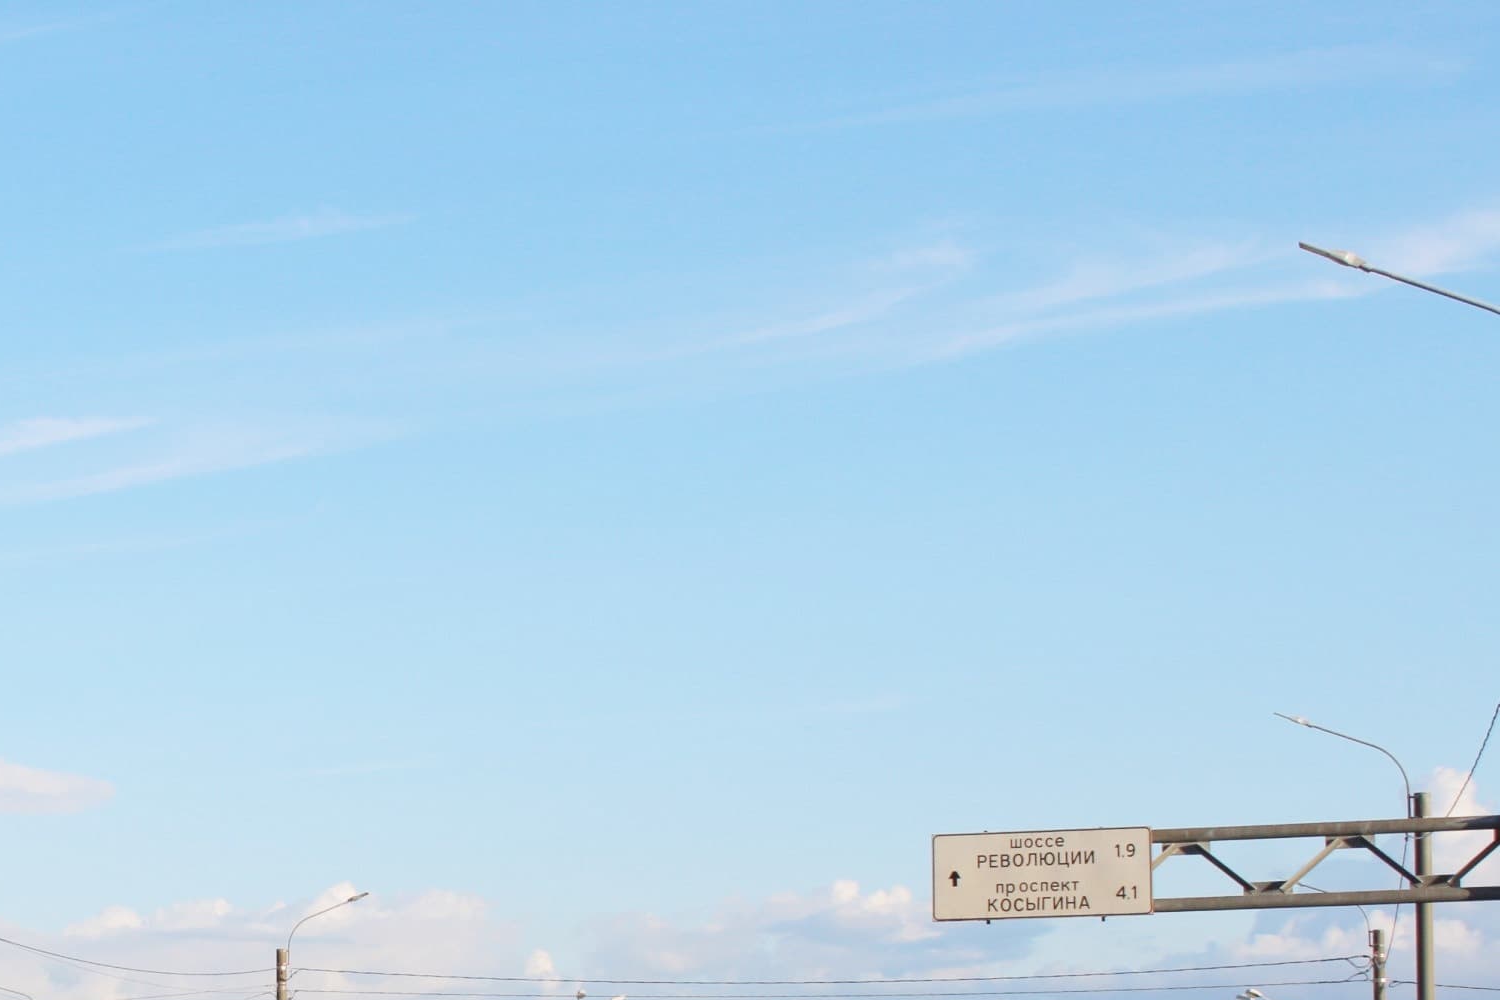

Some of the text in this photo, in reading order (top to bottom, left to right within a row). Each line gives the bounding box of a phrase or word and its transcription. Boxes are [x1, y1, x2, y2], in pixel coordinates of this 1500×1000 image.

[1010, 836, 1065, 849] шоссе
[1114, 843, 1136, 858] 1.9
[977, 850, 1095, 869] РЕВОЛЮЦИИ
[995, 880, 1080, 895] проспект
[1115, 885, 1138, 900] 4.1
[987, 896, 1091, 913] КОСЫГИНА
